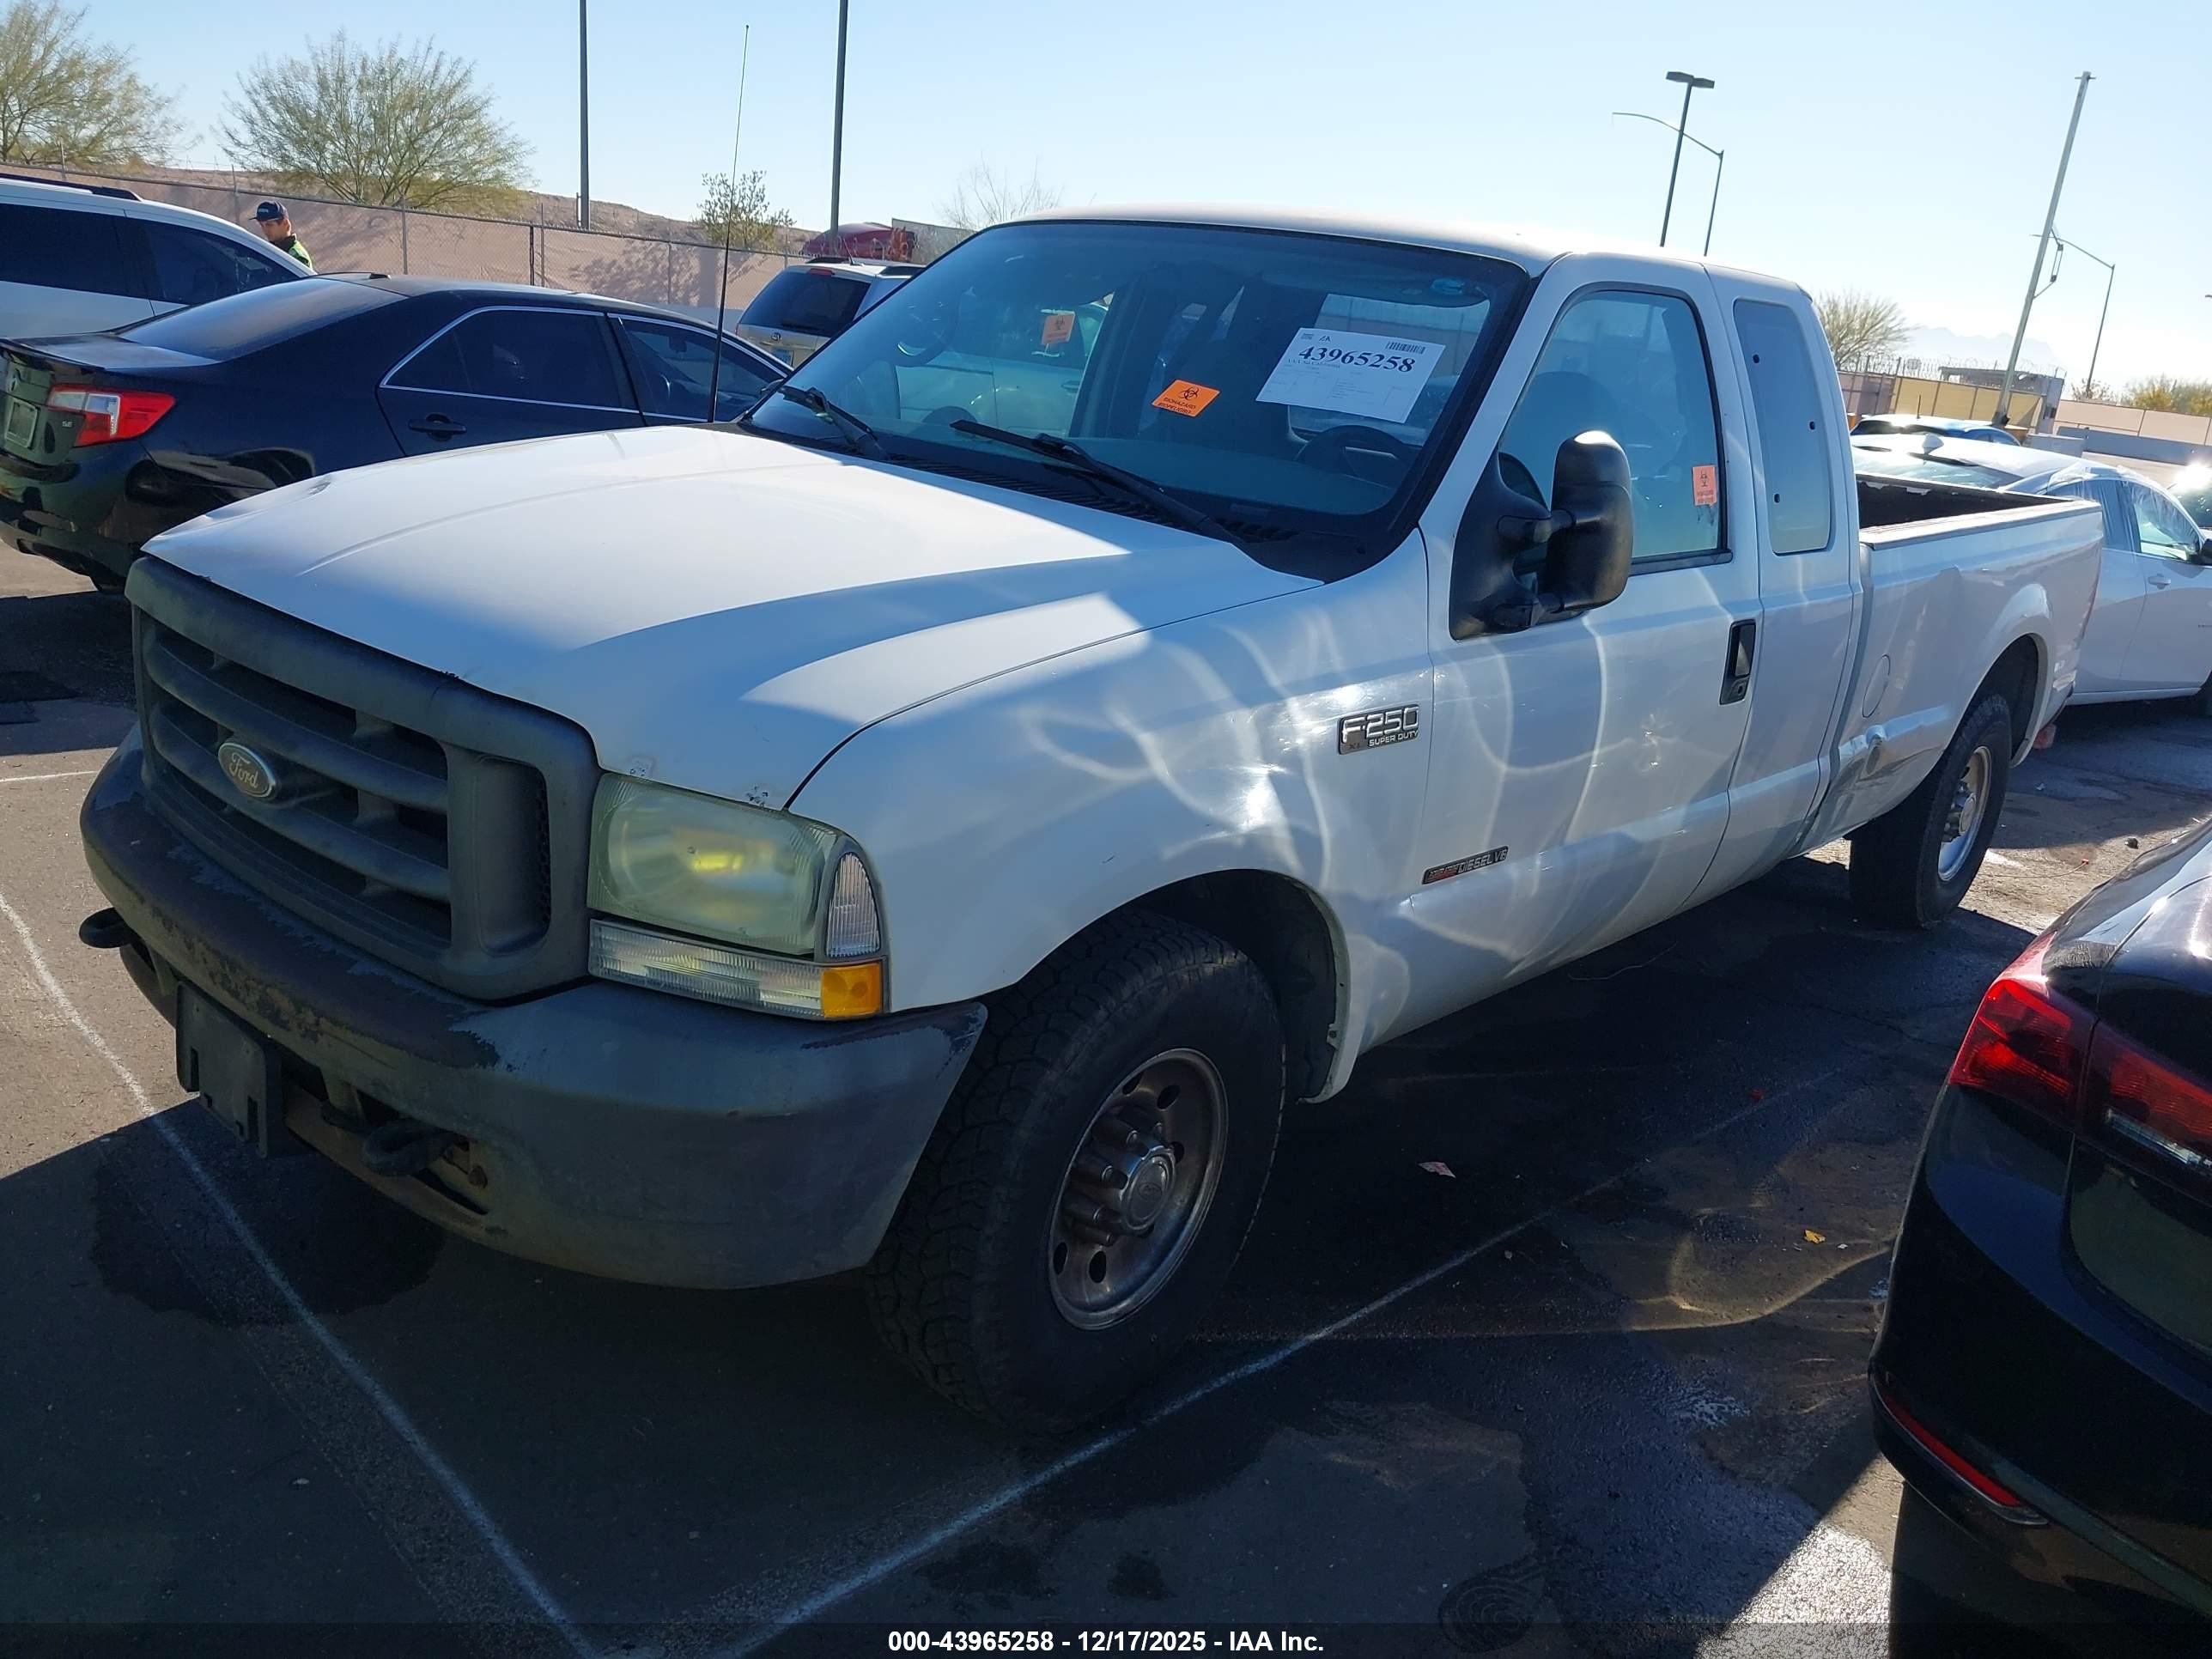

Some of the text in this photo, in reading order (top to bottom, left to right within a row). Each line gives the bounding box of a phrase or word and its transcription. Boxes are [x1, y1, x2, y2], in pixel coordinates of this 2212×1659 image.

[1298, 346, 1416, 373] 43965258
[1369, 730, 1419, 747] SUPER DUTY
[228, 752, 259, 788] Ford
[1457, 854, 1493, 874] DIESEL
